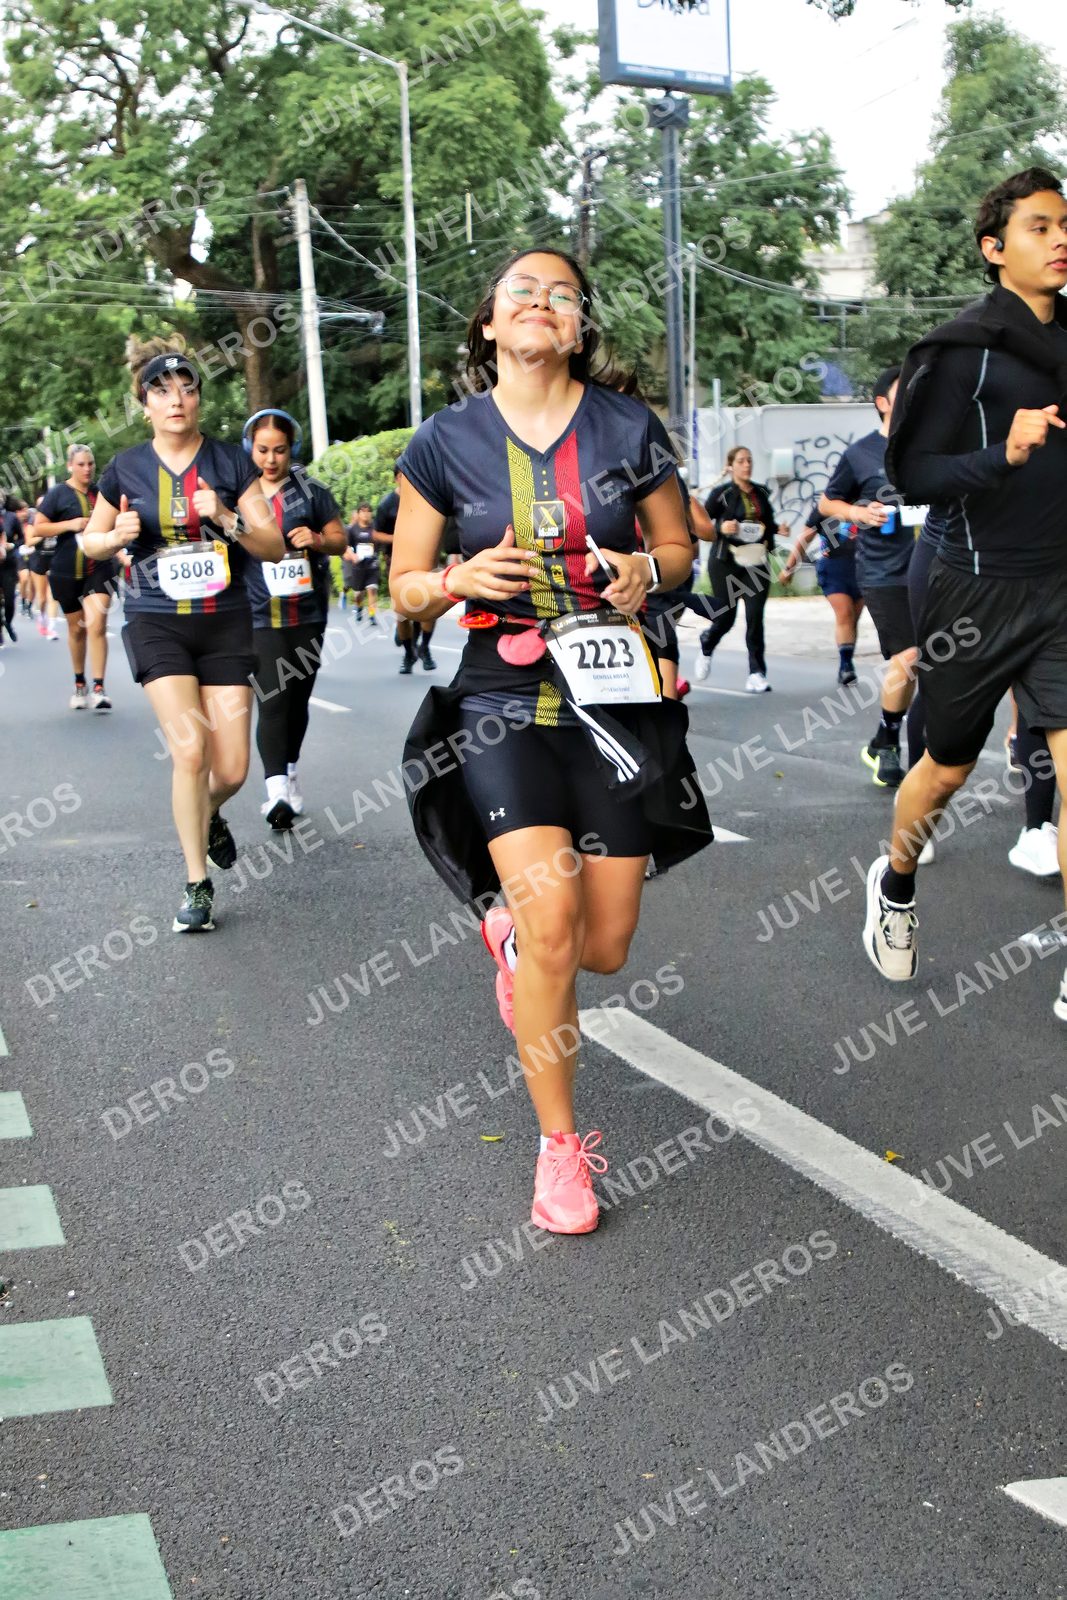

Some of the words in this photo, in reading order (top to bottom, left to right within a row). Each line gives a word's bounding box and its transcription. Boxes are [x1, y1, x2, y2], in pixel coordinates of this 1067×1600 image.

[170, 560, 215, 580] 5808
[271, 564, 305, 580] 1784
[569, 638, 635, 669] 2223
